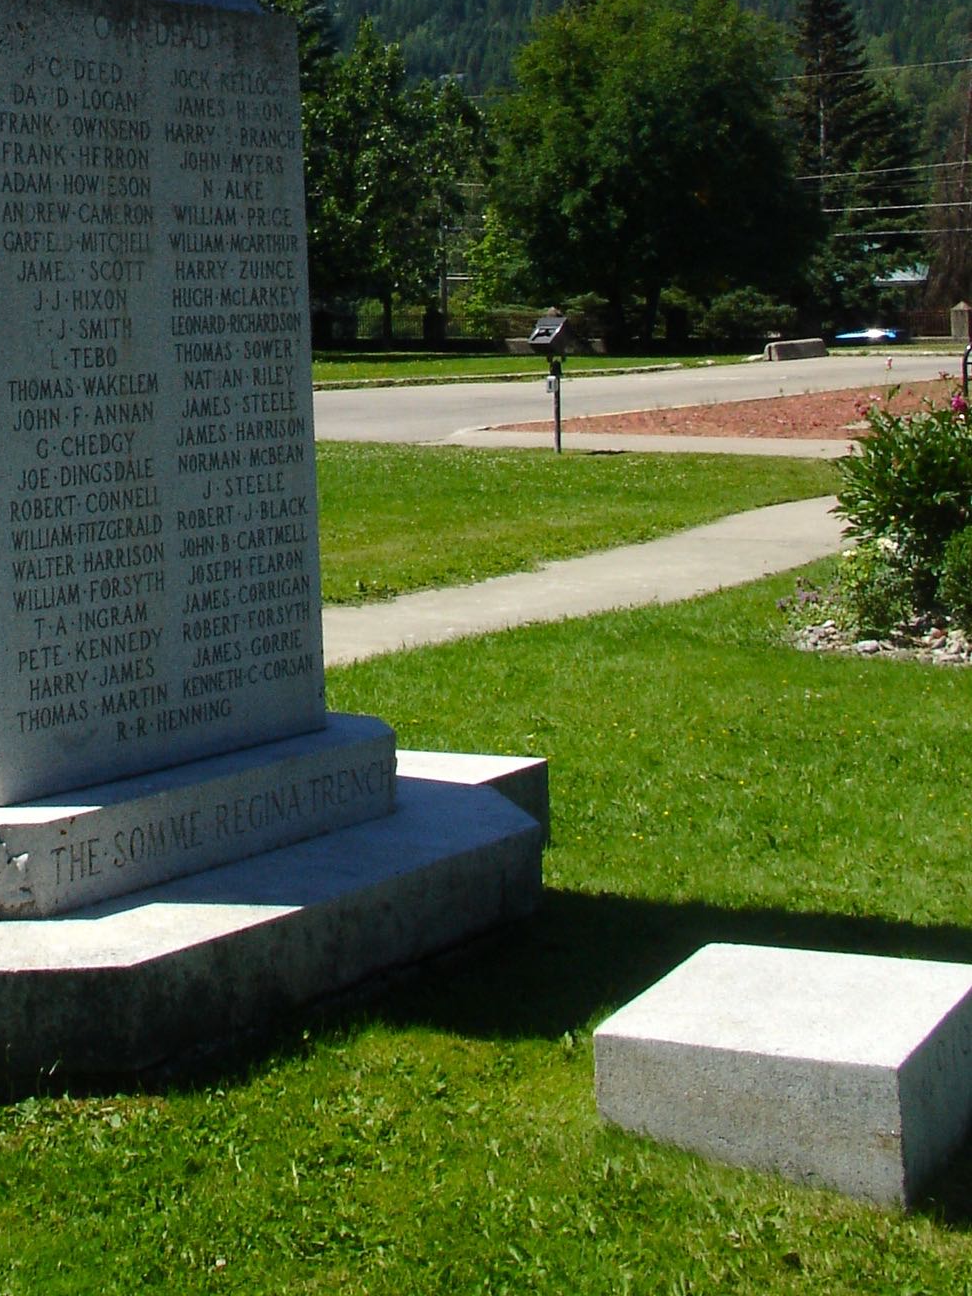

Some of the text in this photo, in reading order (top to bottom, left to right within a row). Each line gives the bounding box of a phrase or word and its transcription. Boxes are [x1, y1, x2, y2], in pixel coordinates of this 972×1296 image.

[94, 15, 141, 43] OR
[49, 58, 62, 78] C
[74, 60, 122, 84] DEED
[170, 70, 289, 97] JOCK KELOC
[82, 90, 138, 112] LOGAN
[175, 97, 225, 118] JAMES
[0, 112, 53, 137] FRANK
[165, 124, 215, 146] HARRY
[240, 128, 296, 150] BRANCH
[2, 142, 149, 169] FRANK HERRON
[180, 151, 283, 174] JOHN MYERS
[2, 173, 151, 197] ADAM HOWIESON
[203, 181, 264, 200] N ALKE
[2, 201, 154, 226] ANDREW CAMERON
[173, 207, 292, 227] WILLIAM PRICE
[81, 232, 150, 254] MITCHELL
[169, 232, 224, 253] WILLIAM
[17, 259, 147, 282] JAMES SCOTT
[175, 259, 295, 281] HARRY ZUINCE
[33, 288, 128, 311] J J HIXON
[172, 288, 214, 308] HUGH
[57, 318, 68, 340] J
[78, 317, 133, 340] SMITH
[171, 312, 302, 336] LEONARD RICHARDSON
[70, 346, 117, 369] TEBO
[174, 341, 232, 363] THOMAS
[9, 372, 159, 403] THOMAS WAKELEM
[252, 365, 296, 387] RILEY
[13, 400, 154, 432] JOHN F ANNAN
[182, 391, 298, 419] JAMES STEELE
[61, 430, 136, 457] CHEDGY
[176, 417, 306, 447] JAMES HARRISON
[17, 457, 155, 492] JOE DINGSDALE
[178, 450, 241, 474] NORMAN
[202, 471, 286, 501] J STEELE
[9, 486, 161, 523] ROBERT CONNELL
[176, 495, 308, 533] ROBERT J BLACK
[11, 514, 163, 552] WILLIAM FITZGERALD
[179, 523, 308, 560] JOHN B CARTMELL
[12, 543, 165, 583] WALTER HARRISON
[188, 549, 303, 585] JOSEPH FEARON
[13, 571, 165, 613] WILLIAM FORSYTH
[182, 575, 311, 614] JAMES CORRIGAN
[35, 603, 148, 639] T A INGRAM
[182, 601, 311, 643] ROBERT FORSYTH
[18, 628, 163, 673] PETE KENNEDY
[192, 630, 303, 668] JAMES GORRIE
[29, 657, 155, 701] HARRY JAMES
[182, 654, 315, 698] KENNETH C CORSAN
[17, 683, 169, 734] THOMAS MARTIN
[116, 698, 232, 742] R R HENNING
[50, 758, 392, 885] THE SOMME REGINA TRENCH
